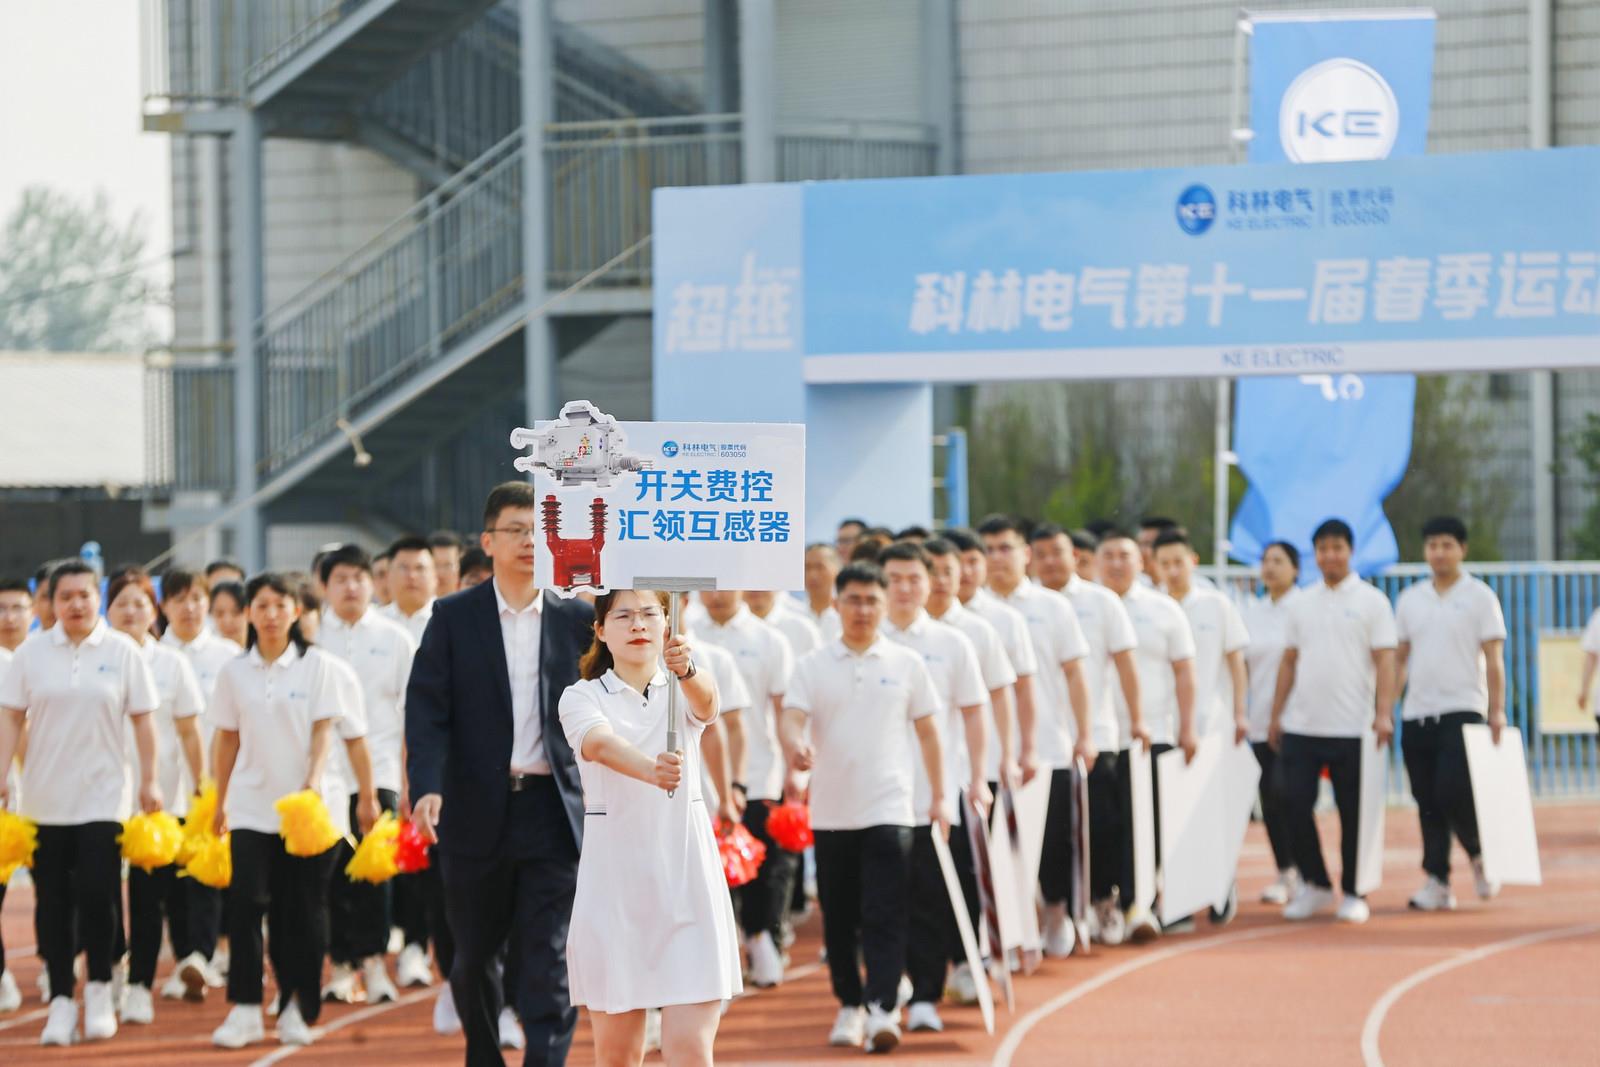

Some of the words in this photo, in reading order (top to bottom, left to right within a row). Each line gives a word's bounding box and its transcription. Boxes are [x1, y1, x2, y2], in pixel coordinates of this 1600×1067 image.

[1297, 110, 1382, 138] KE
[665, 250, 800, 354] 超越
[1221, 351, 1242, 368] KE
[1252, 347, 1344, 368] ELECTRIC
[683, 443, 717, 452] 科林电气
[635, 469, 774, 503] 开关费控
[618, 509, 790, 543] 汇领互感器
